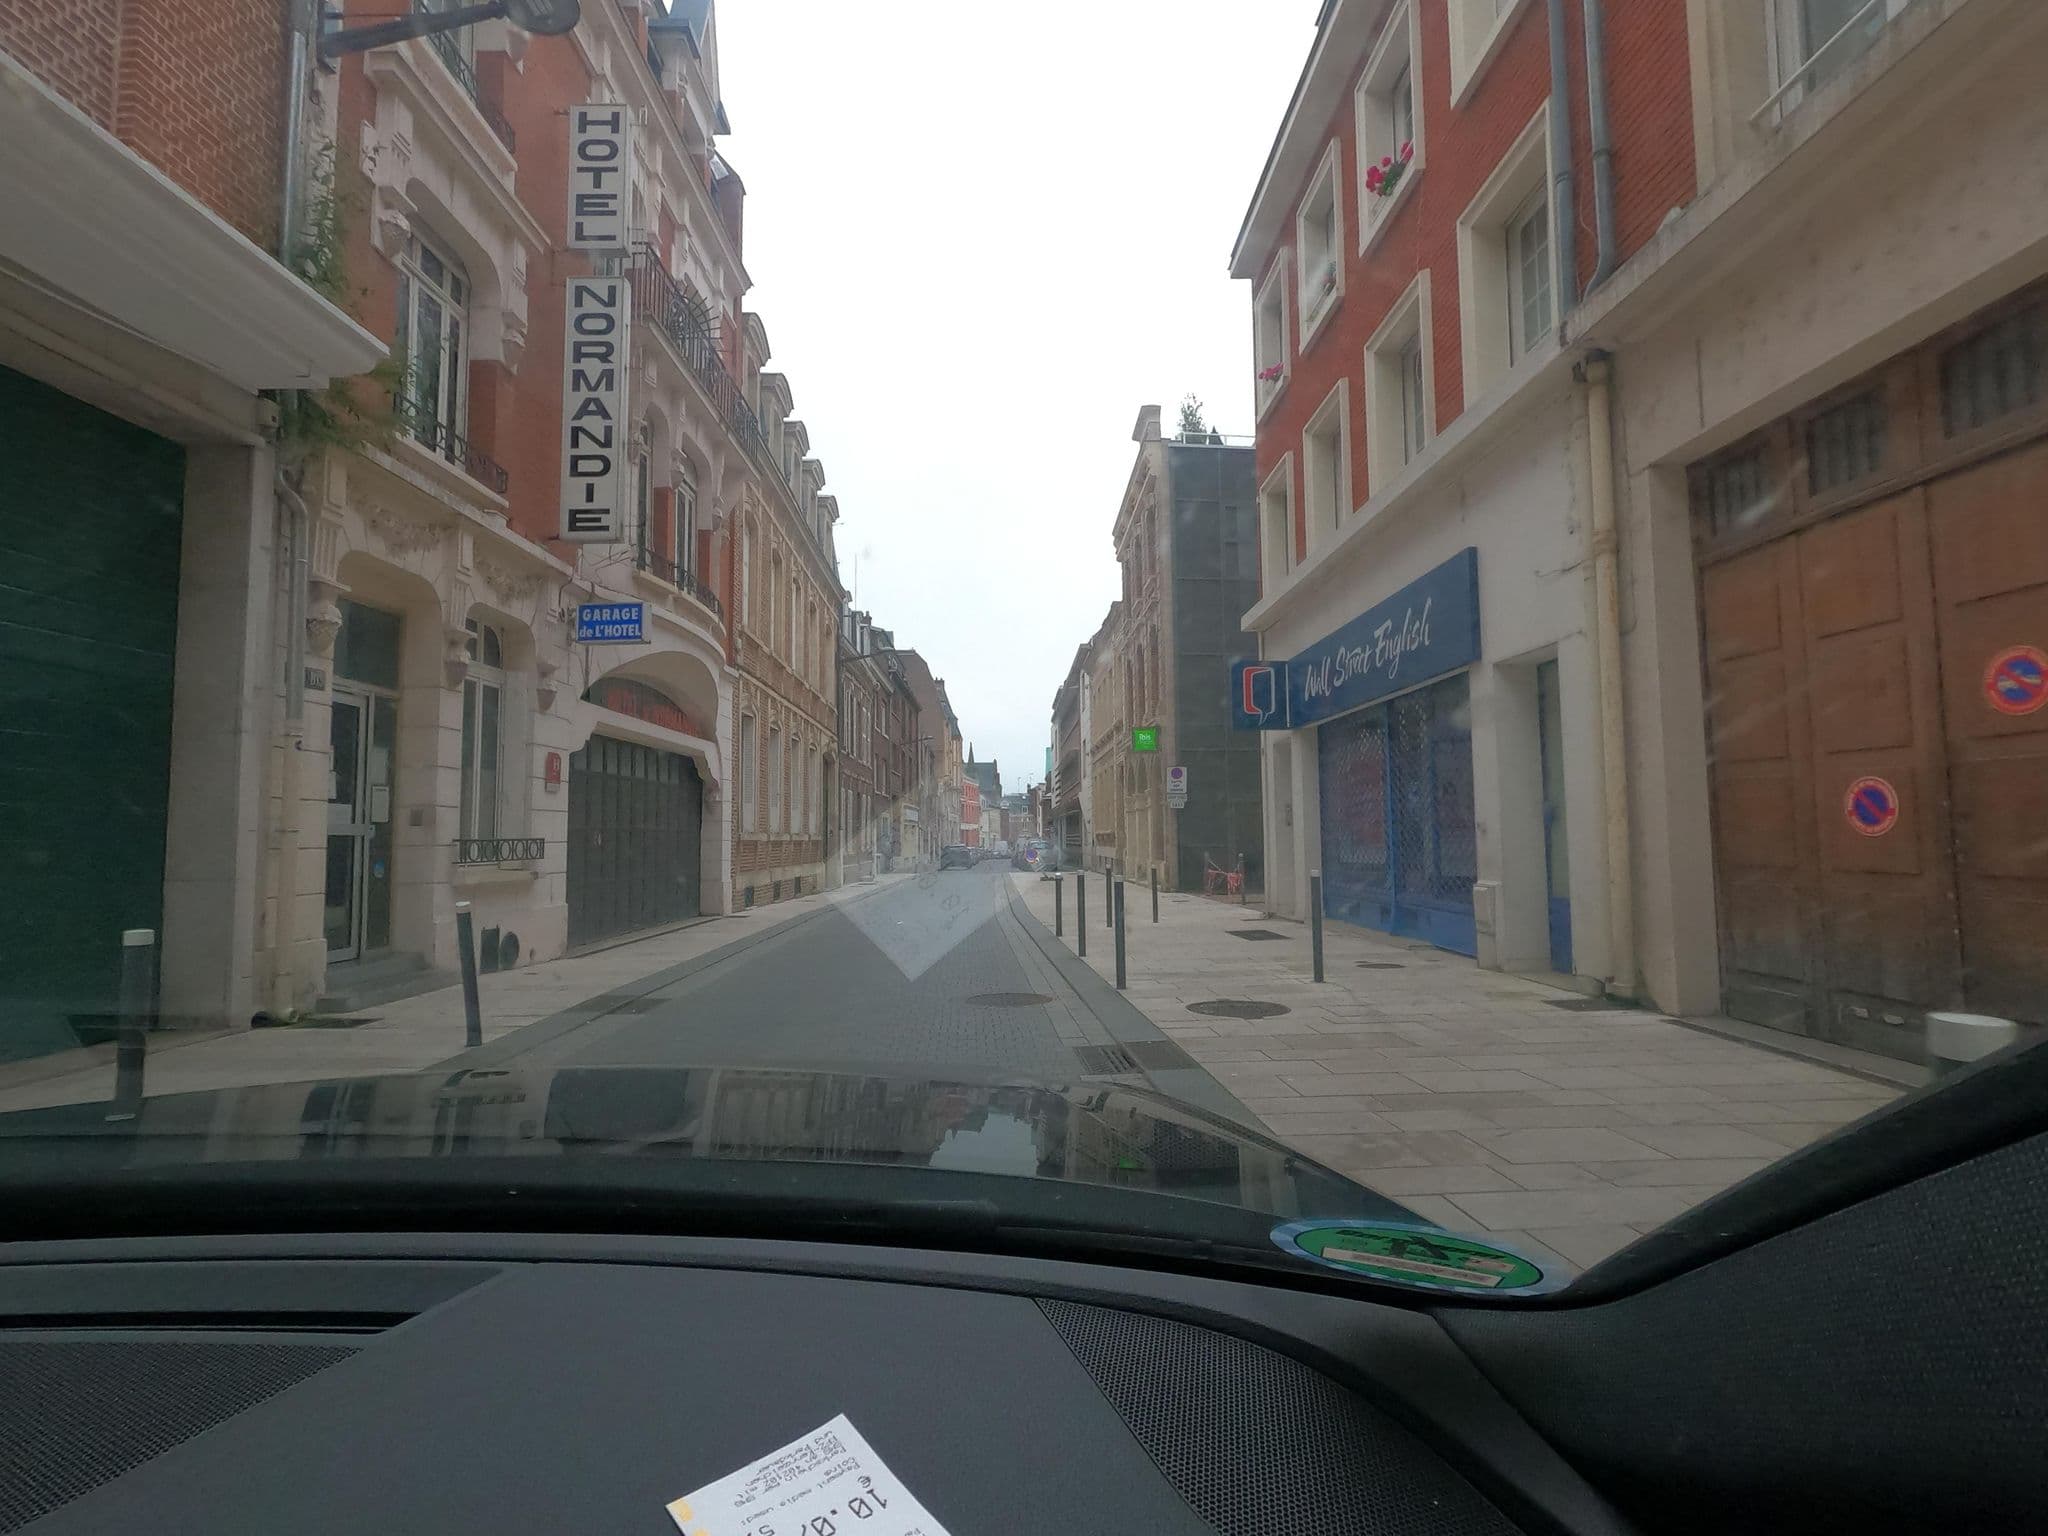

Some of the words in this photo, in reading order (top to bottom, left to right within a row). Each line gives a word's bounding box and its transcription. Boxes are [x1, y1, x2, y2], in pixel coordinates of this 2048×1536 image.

[575, 111, 621, 242] HOTEL
[568, 285, 617, 532] NORMANDIE
[580, 625, 594, 637] de
[595, 623, 640, 637] L'HOTEL
[582, 607, 639, 620] GARAGE
[1374, 597, 1432, 680] English
[858, 1477, 870, 1488] €
